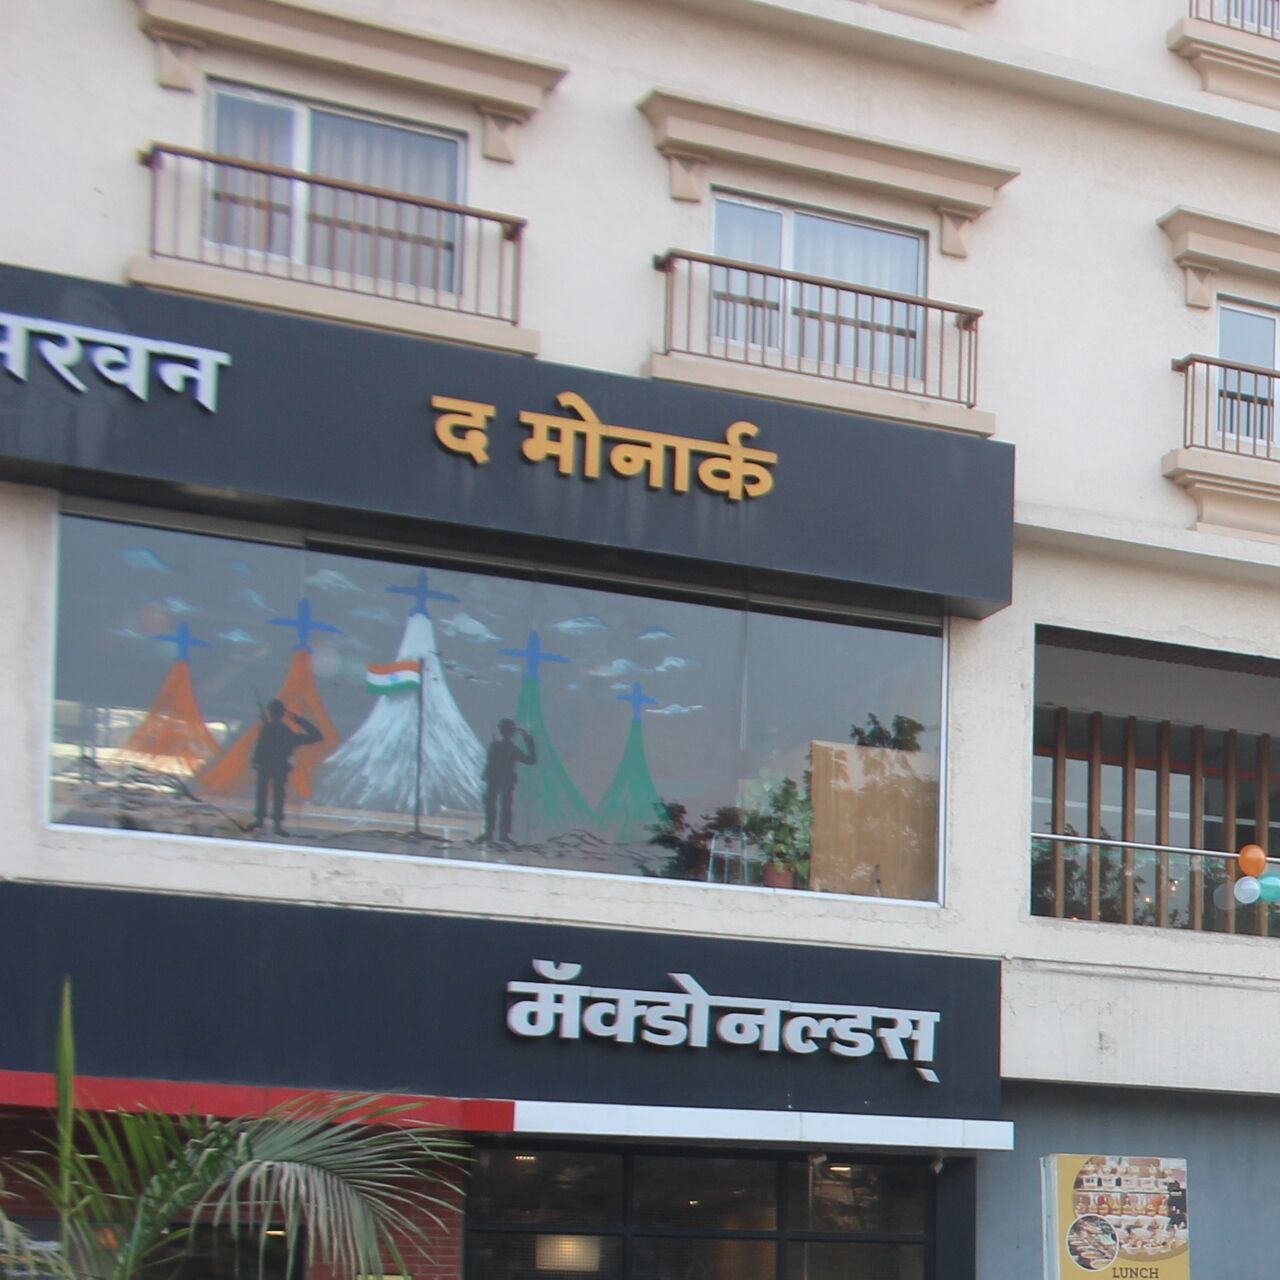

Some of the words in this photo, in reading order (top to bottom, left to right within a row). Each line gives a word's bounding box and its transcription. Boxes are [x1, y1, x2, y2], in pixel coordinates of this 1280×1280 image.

[431, 394, 496, 465] द
[519, 390, 778, 501] मोनार्क
[1112, 1267, 1159, 1279] LUNCH
